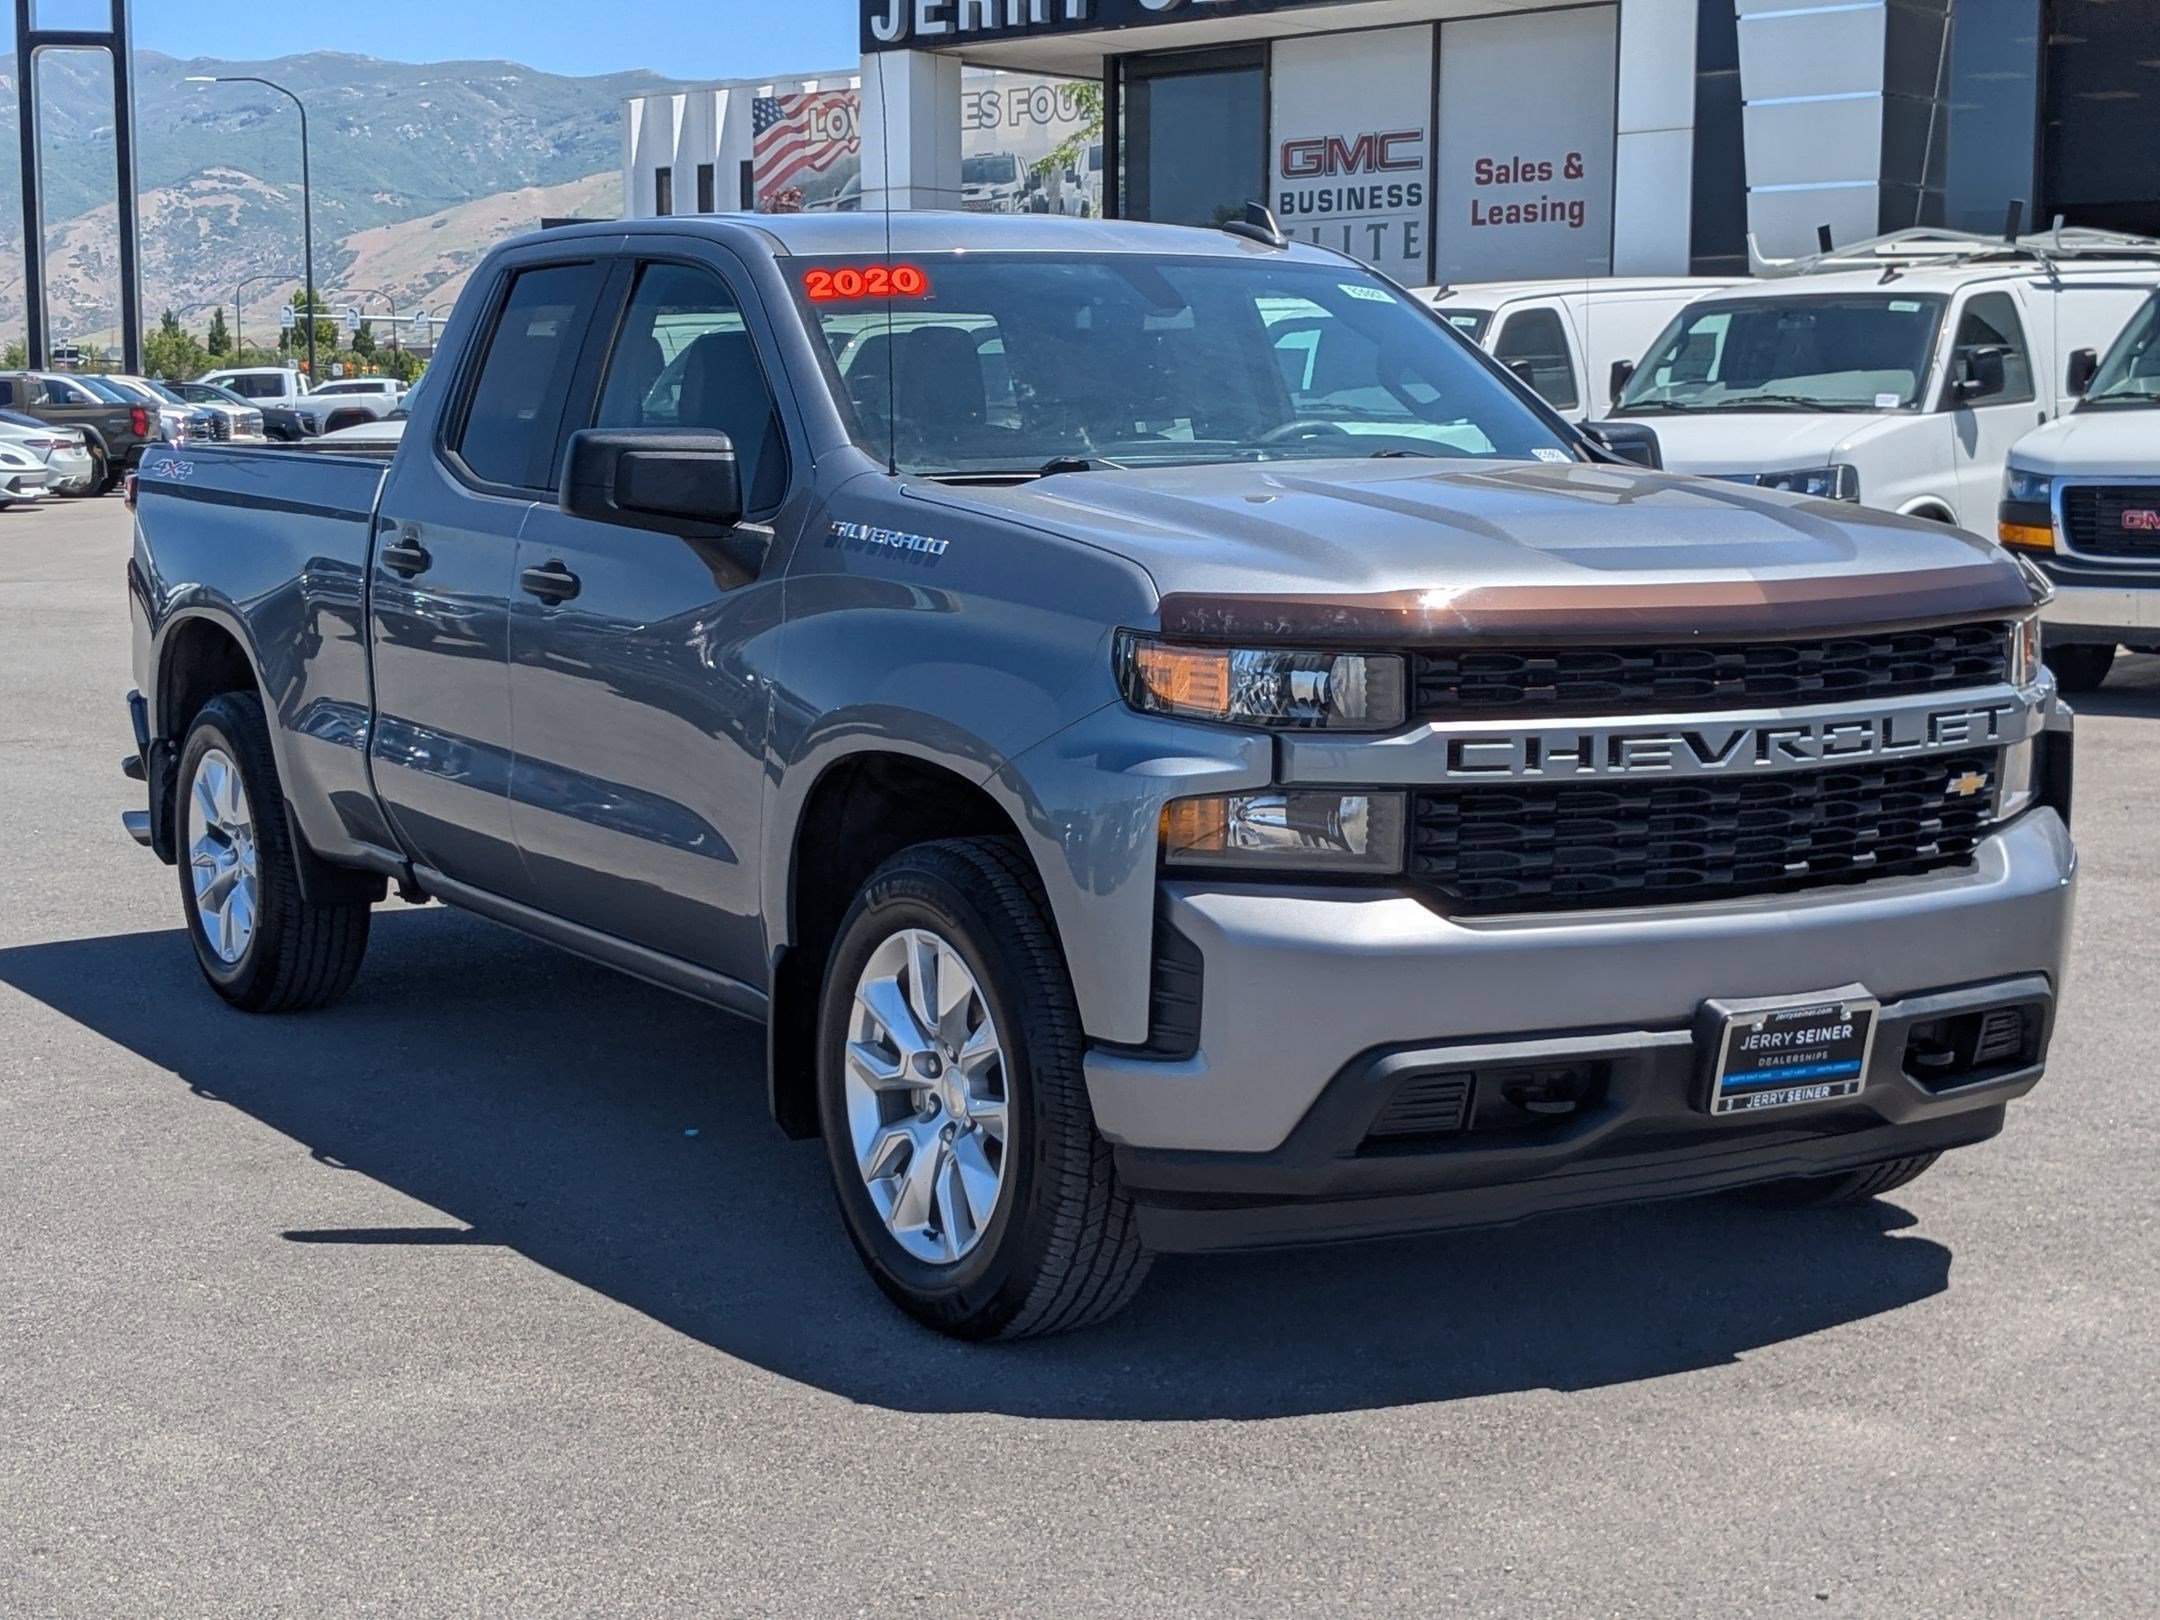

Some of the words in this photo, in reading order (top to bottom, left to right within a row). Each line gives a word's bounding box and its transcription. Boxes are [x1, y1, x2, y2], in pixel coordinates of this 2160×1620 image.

[1008, 85, 1091, 126] FOU
[1281, 128, 1423, 179] GMC
[1474, 156, 1552, 186] Sales
[1563, 152, 1585, 180] &
[1279, 183, 1422, 215] BUSINESS
[1471, 195, 1585, 228] Leasing
[1281, 221, 1421, 261] ITE
[804, 265, 927, 299] 2020
[152, 458, 194, 480] 4X4
[2121, 509, 2160, 530] GM
[831, 520, 950, 556] SILVERADO
[1447, 703, 2014, 777] CHEVROLET
[1740, 1031, 1794, 1050] JERRY
[1796, 1024, 1853, 1044] SEINER
[1758, 1051, 1828, 1067] DEALERSHIPS
[1747, 1091, 1785, 1108] JERRY
[1787, 1086, 1831, 1103] SEINER
